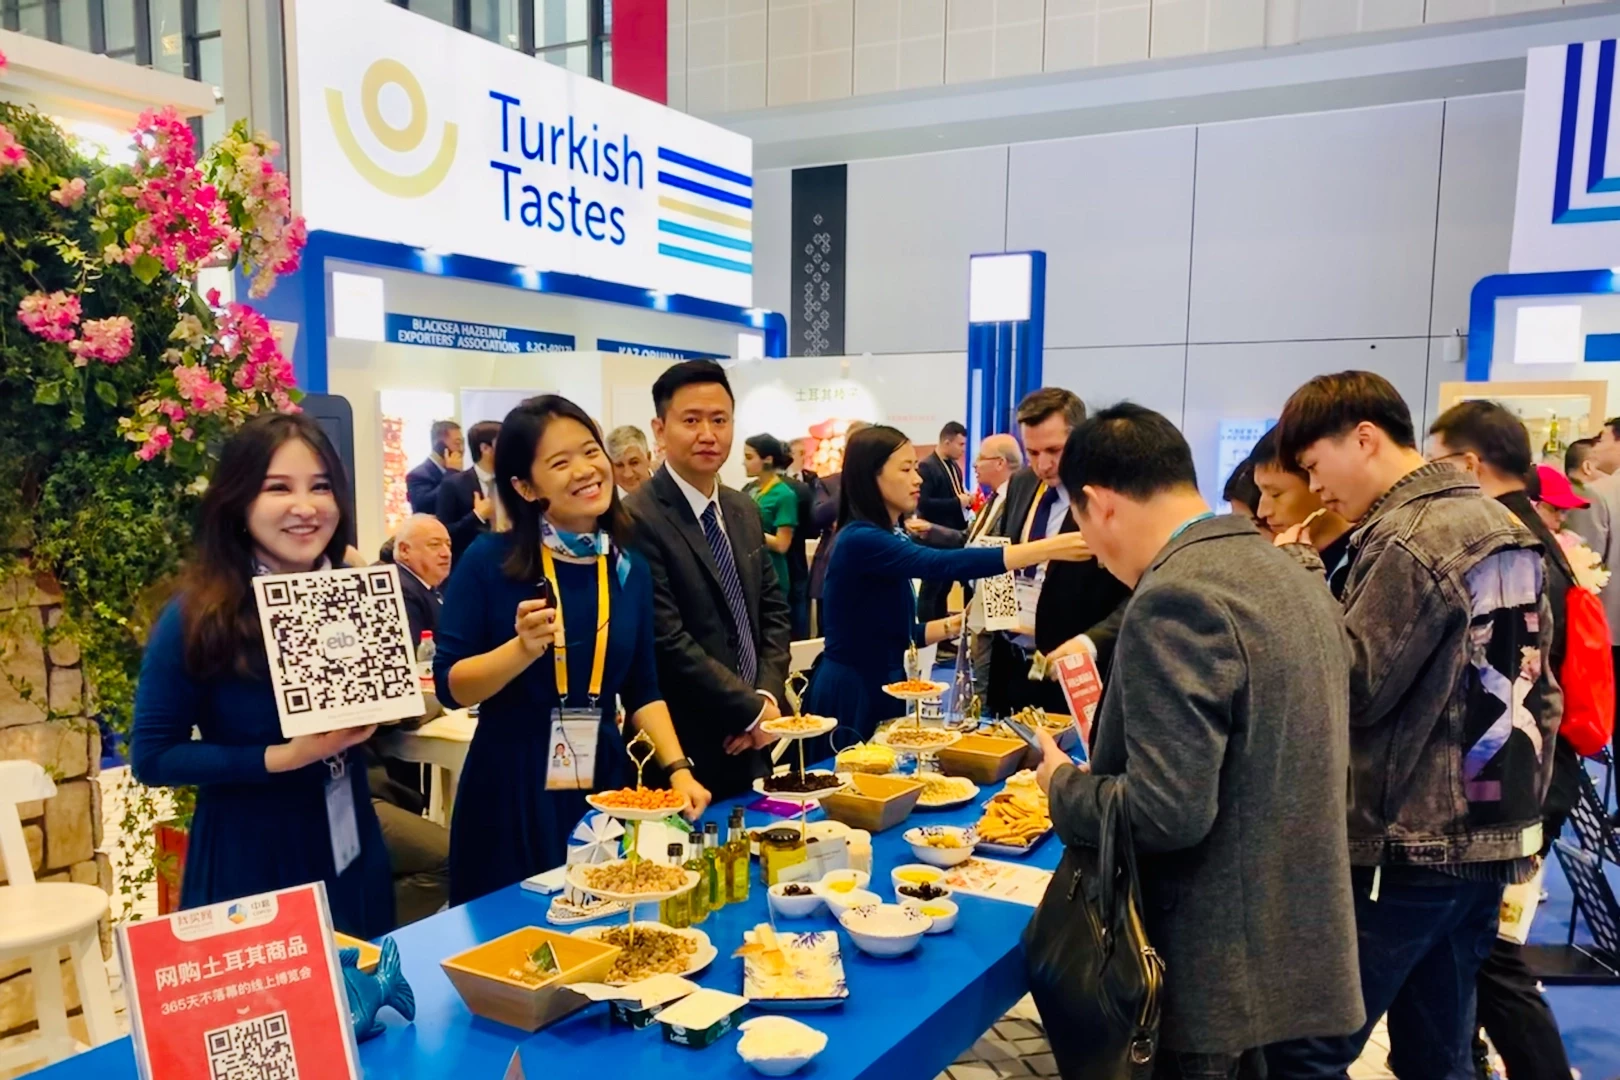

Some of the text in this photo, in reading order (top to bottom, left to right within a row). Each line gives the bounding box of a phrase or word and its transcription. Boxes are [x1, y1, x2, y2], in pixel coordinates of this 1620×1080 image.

[489, 90, 643, 190] Turkish
[490, 160, 625, 246] Tastes
[398, 329, 456, 346] EXPORTERS'
[457, 335, 520, 353] ASSOCIATIONS
[412, 318, 507, 340] BLACKSEA HAZELNUT
[326, 631, 356, 650] eib
[155, 935, 308, 992] 网购土耳其商品
[160, 965, 312, 1016] 365天不落幕的线上博览会
